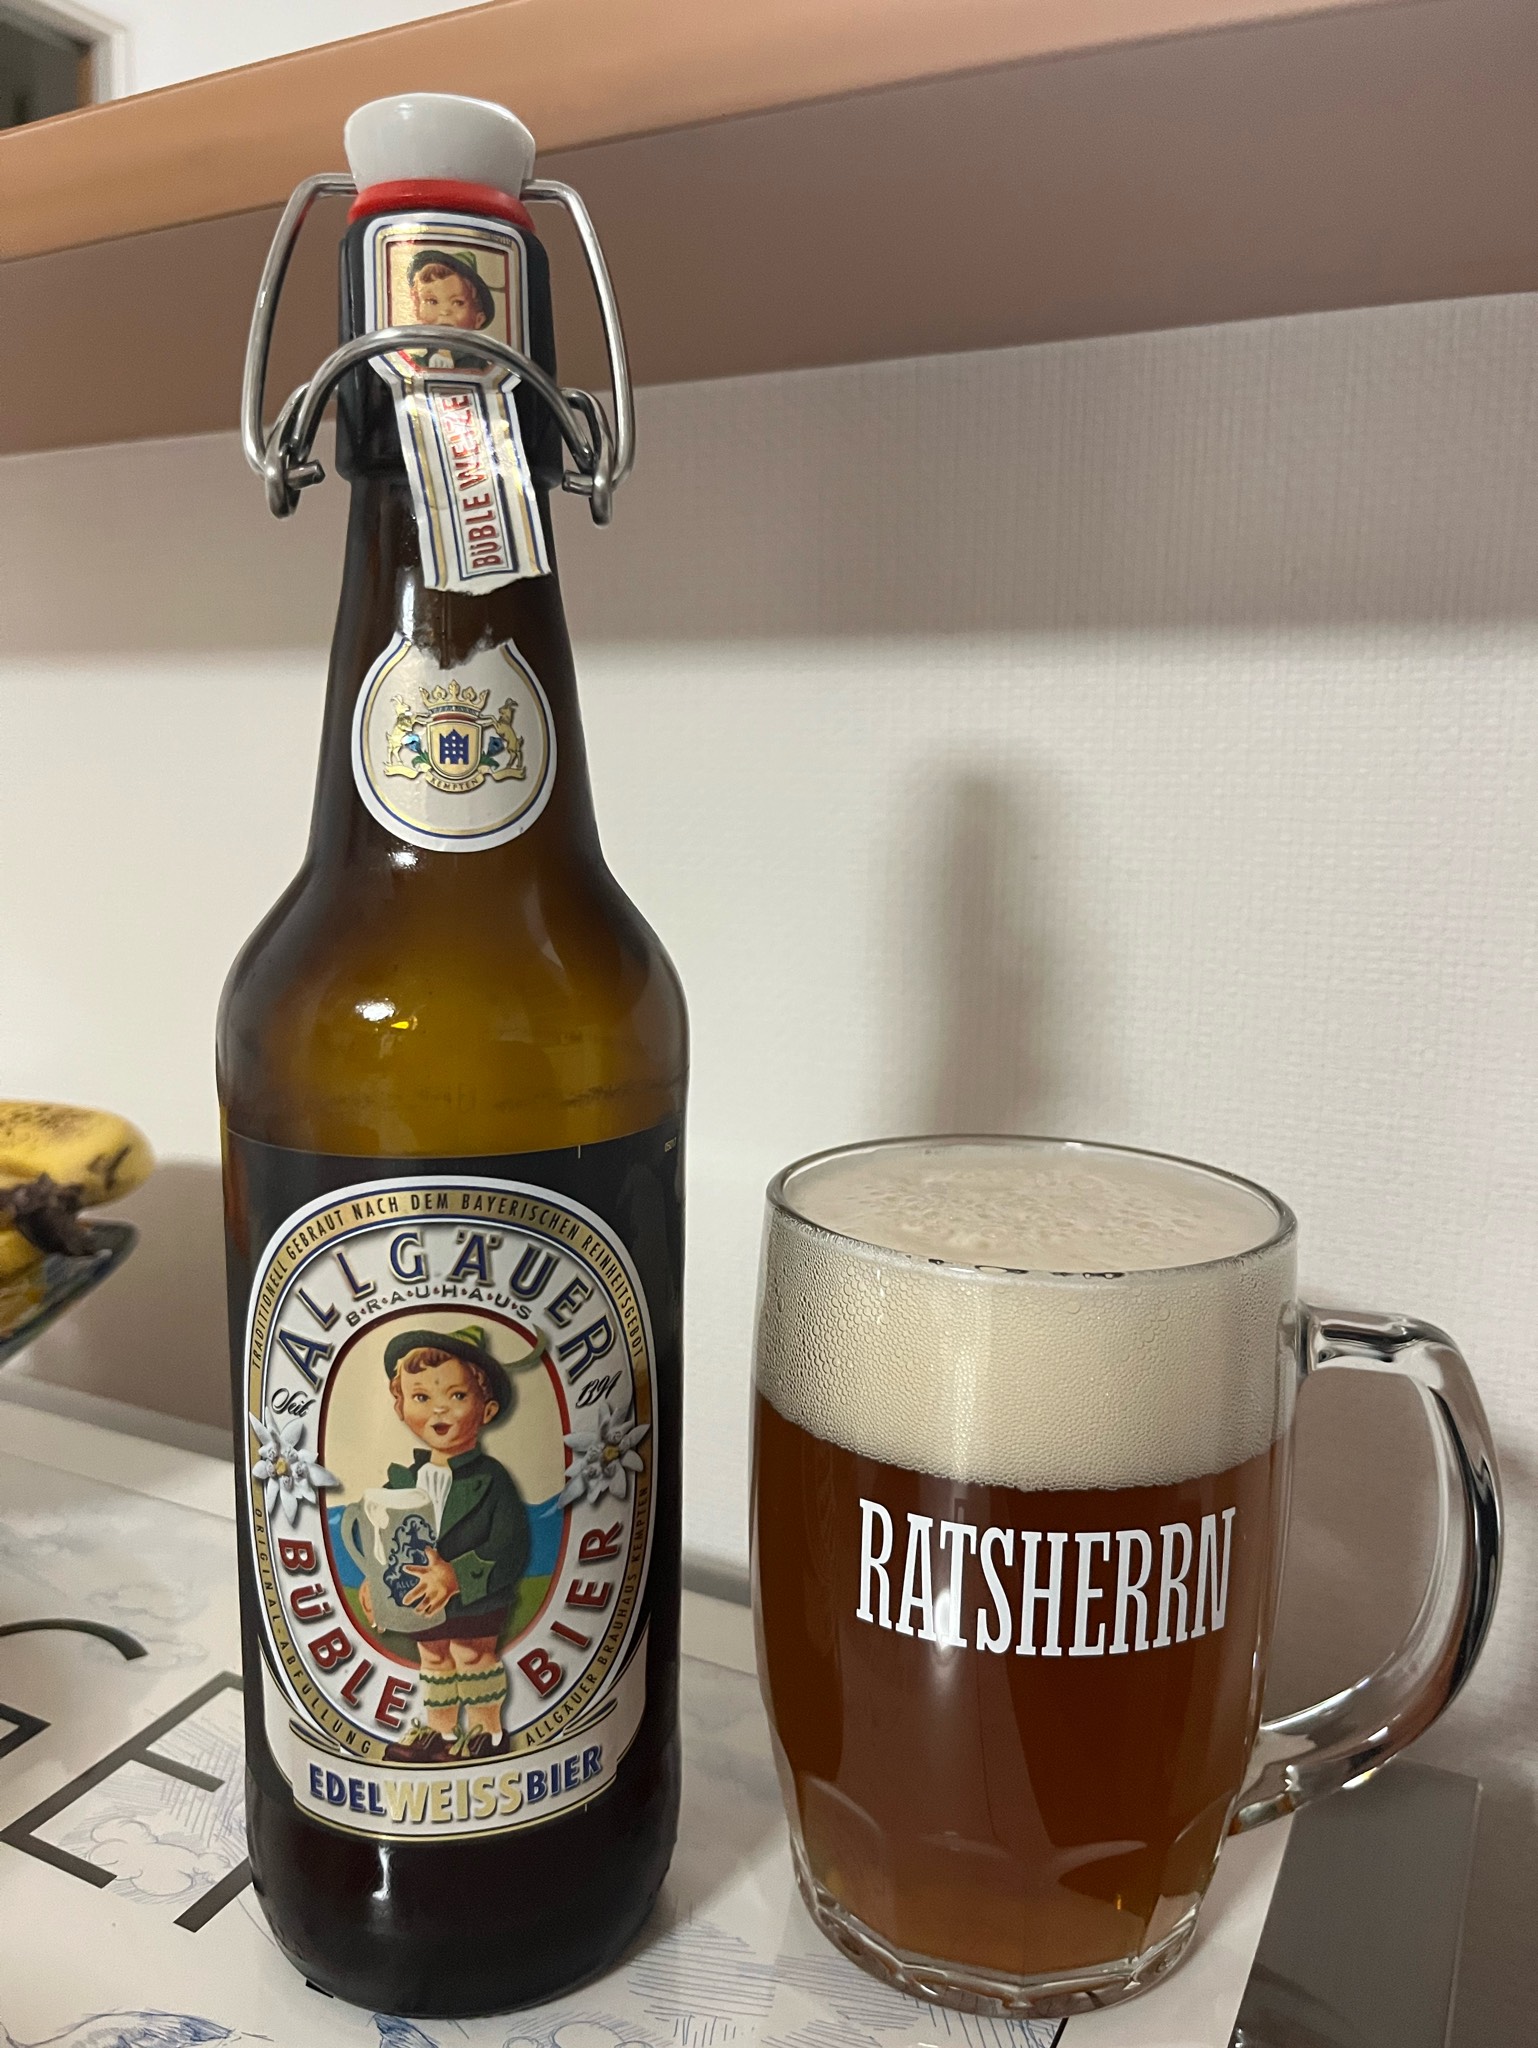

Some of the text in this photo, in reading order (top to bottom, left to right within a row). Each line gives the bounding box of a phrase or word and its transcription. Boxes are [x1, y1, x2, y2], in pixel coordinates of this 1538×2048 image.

[462, 492, 502, 570] BÜBLE
[430, 777, 479, 791] KEMPTEN
[252, 1193, 647, 1369] TRADITIONELL GEBRAUT NACH DEM BAYERISCHEN REINHEITSGEBOT
[277, 1230, 615, 1387] ALLGÄUER
[271, 1388, 316, 1418] Seit
[277, 1537, 413, 1727] BÜBLE
[518, 1522, 622, 1698] BIER
[524, 1485, 648, 1748] ALLGÄUER BRAUHAUS KEMPTEN
[857, 1499, 1235, 1657] RATSHERRN
[310, 1745, 602, 1822] EDELWEISSBIER
